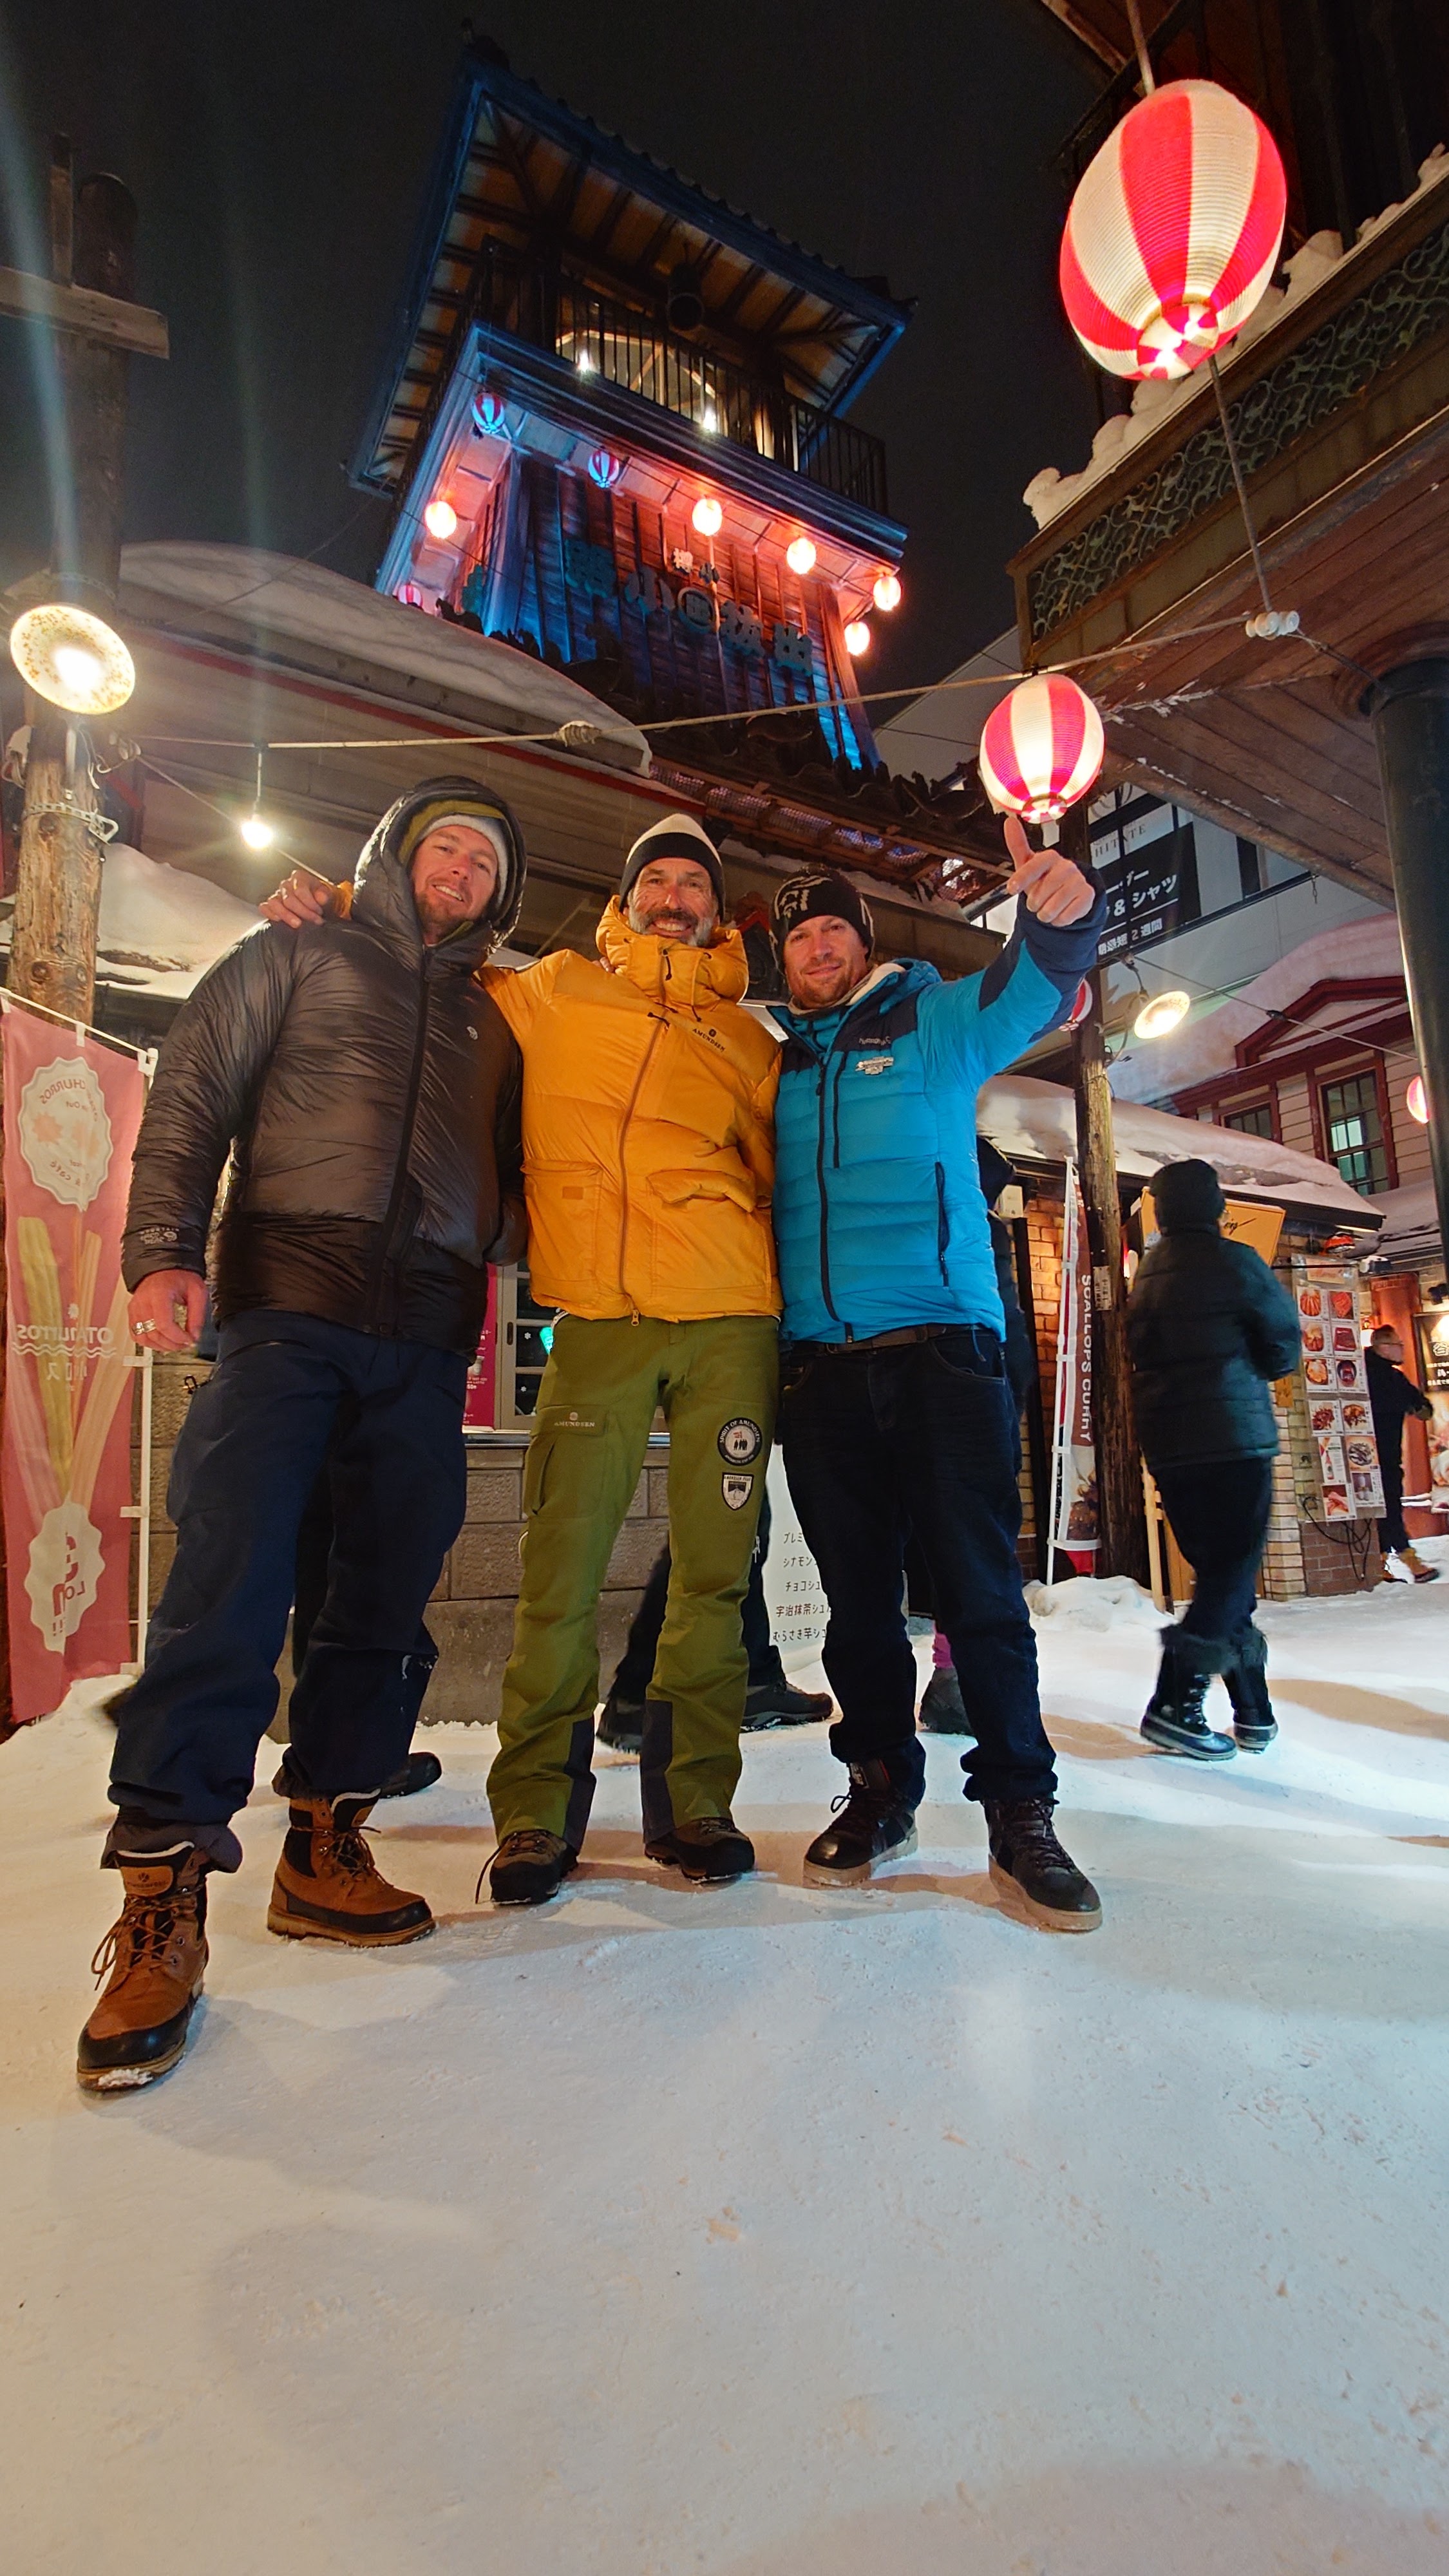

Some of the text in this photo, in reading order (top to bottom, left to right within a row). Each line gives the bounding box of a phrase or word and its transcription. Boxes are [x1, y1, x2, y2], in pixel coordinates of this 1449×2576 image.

[1113, 875, 1177, 916] & シャツ
[1132, 929, 1139, 941] 2
[1141, 918, 1162, 937] 週間
[692, 1028, 726, 1052] AMUNDSEN
[1081, 1274, 1092, 1373] SCALLOPS
[719, 1425, 730, 1443] SPIRIT
[783, 1556, 817, 1568] シナモン
